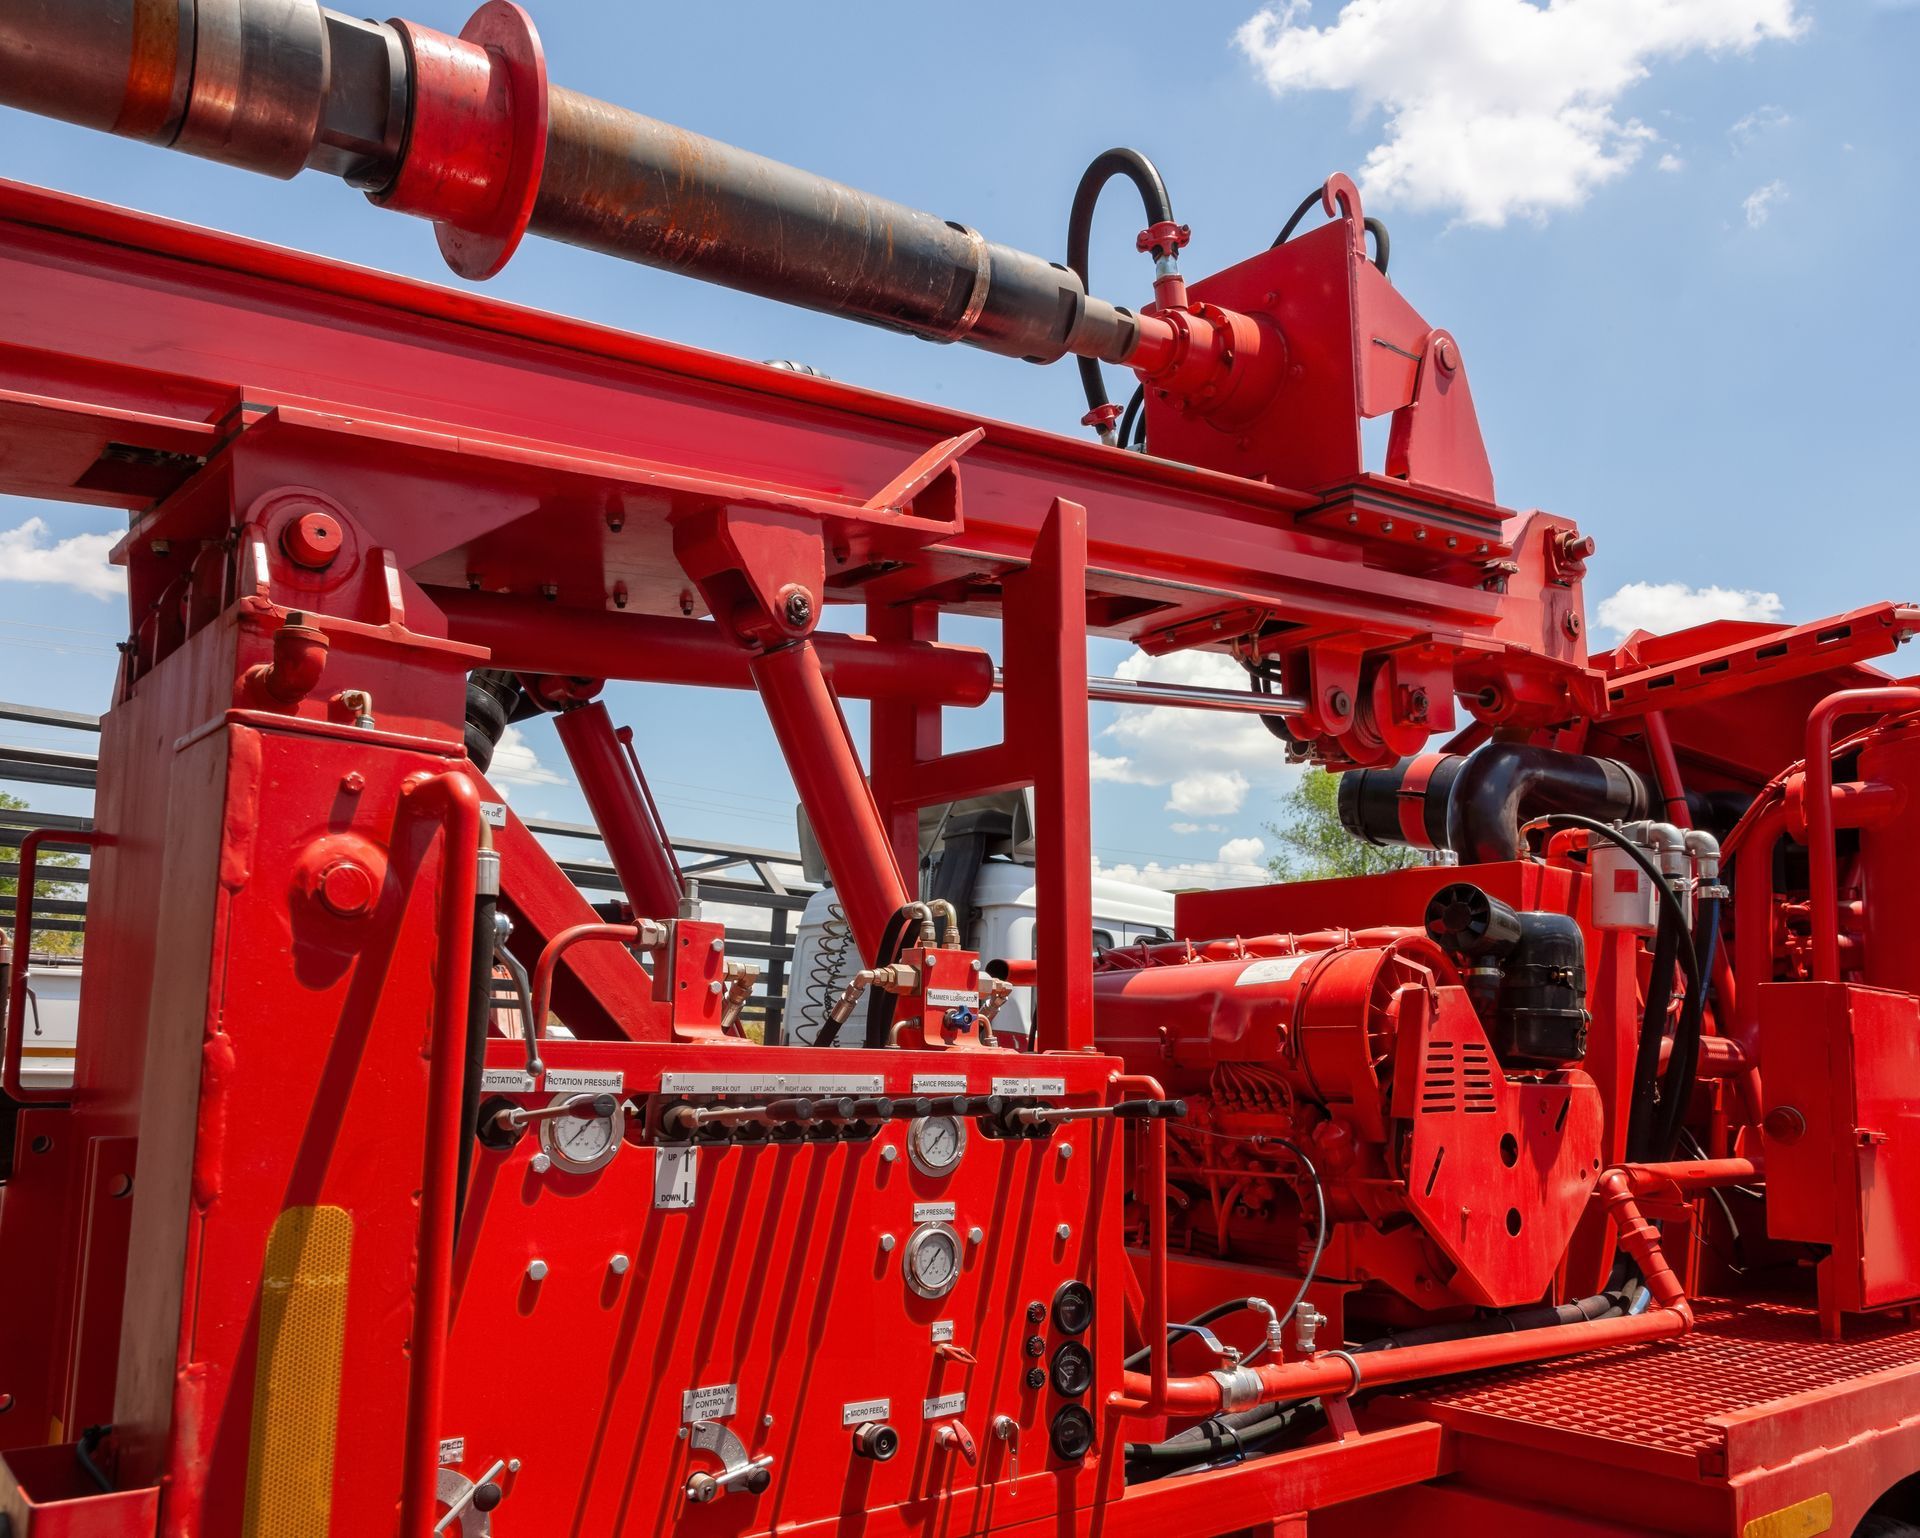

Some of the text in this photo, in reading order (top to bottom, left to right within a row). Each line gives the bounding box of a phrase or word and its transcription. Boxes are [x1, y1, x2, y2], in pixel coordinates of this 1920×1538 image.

[486, 1076, 523, 1084] ROTATION
[548, 1077, 620, 1087] ROTATION PRESSURE
[668, 1153, 677, 1161] UP
[661, 1194, 681, 1202] DOWN
[691, 1386, 730, 1399] VALVE BANK
[695, 1397, 725, 1409] CONTROL
[932, 1400, 957, 1412] THROTTLE
[701, 1409, 719, 1418] FLOW
[850, 1406, 883, 1417] MICRO FEED
[440, 1441, 463, 1450] PEED
